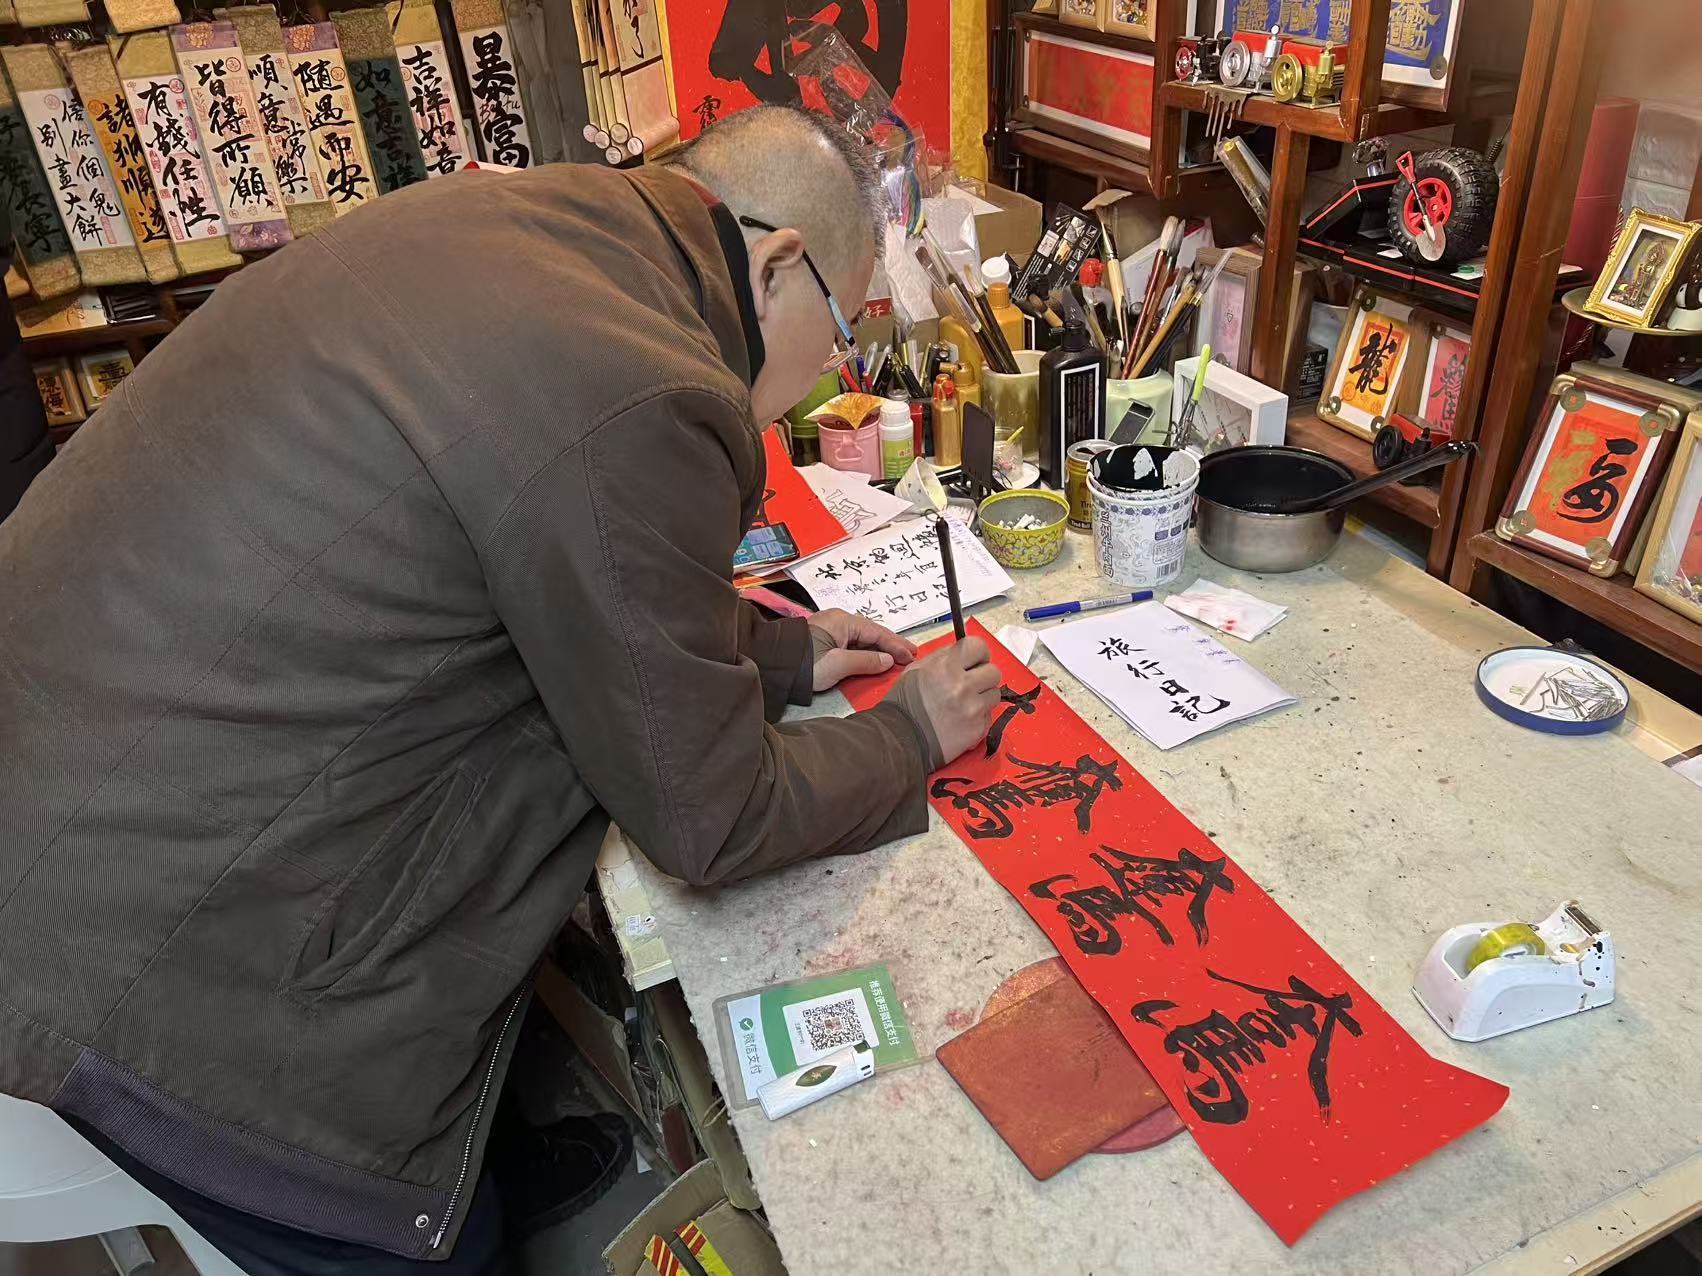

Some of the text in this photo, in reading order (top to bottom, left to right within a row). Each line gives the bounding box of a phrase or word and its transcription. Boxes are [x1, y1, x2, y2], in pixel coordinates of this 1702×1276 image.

[194, 59, 274, 208] 皆得所願
[472, 31, 529, 169] 暴富
[743, 1033, 762, 1075] 微信支付
